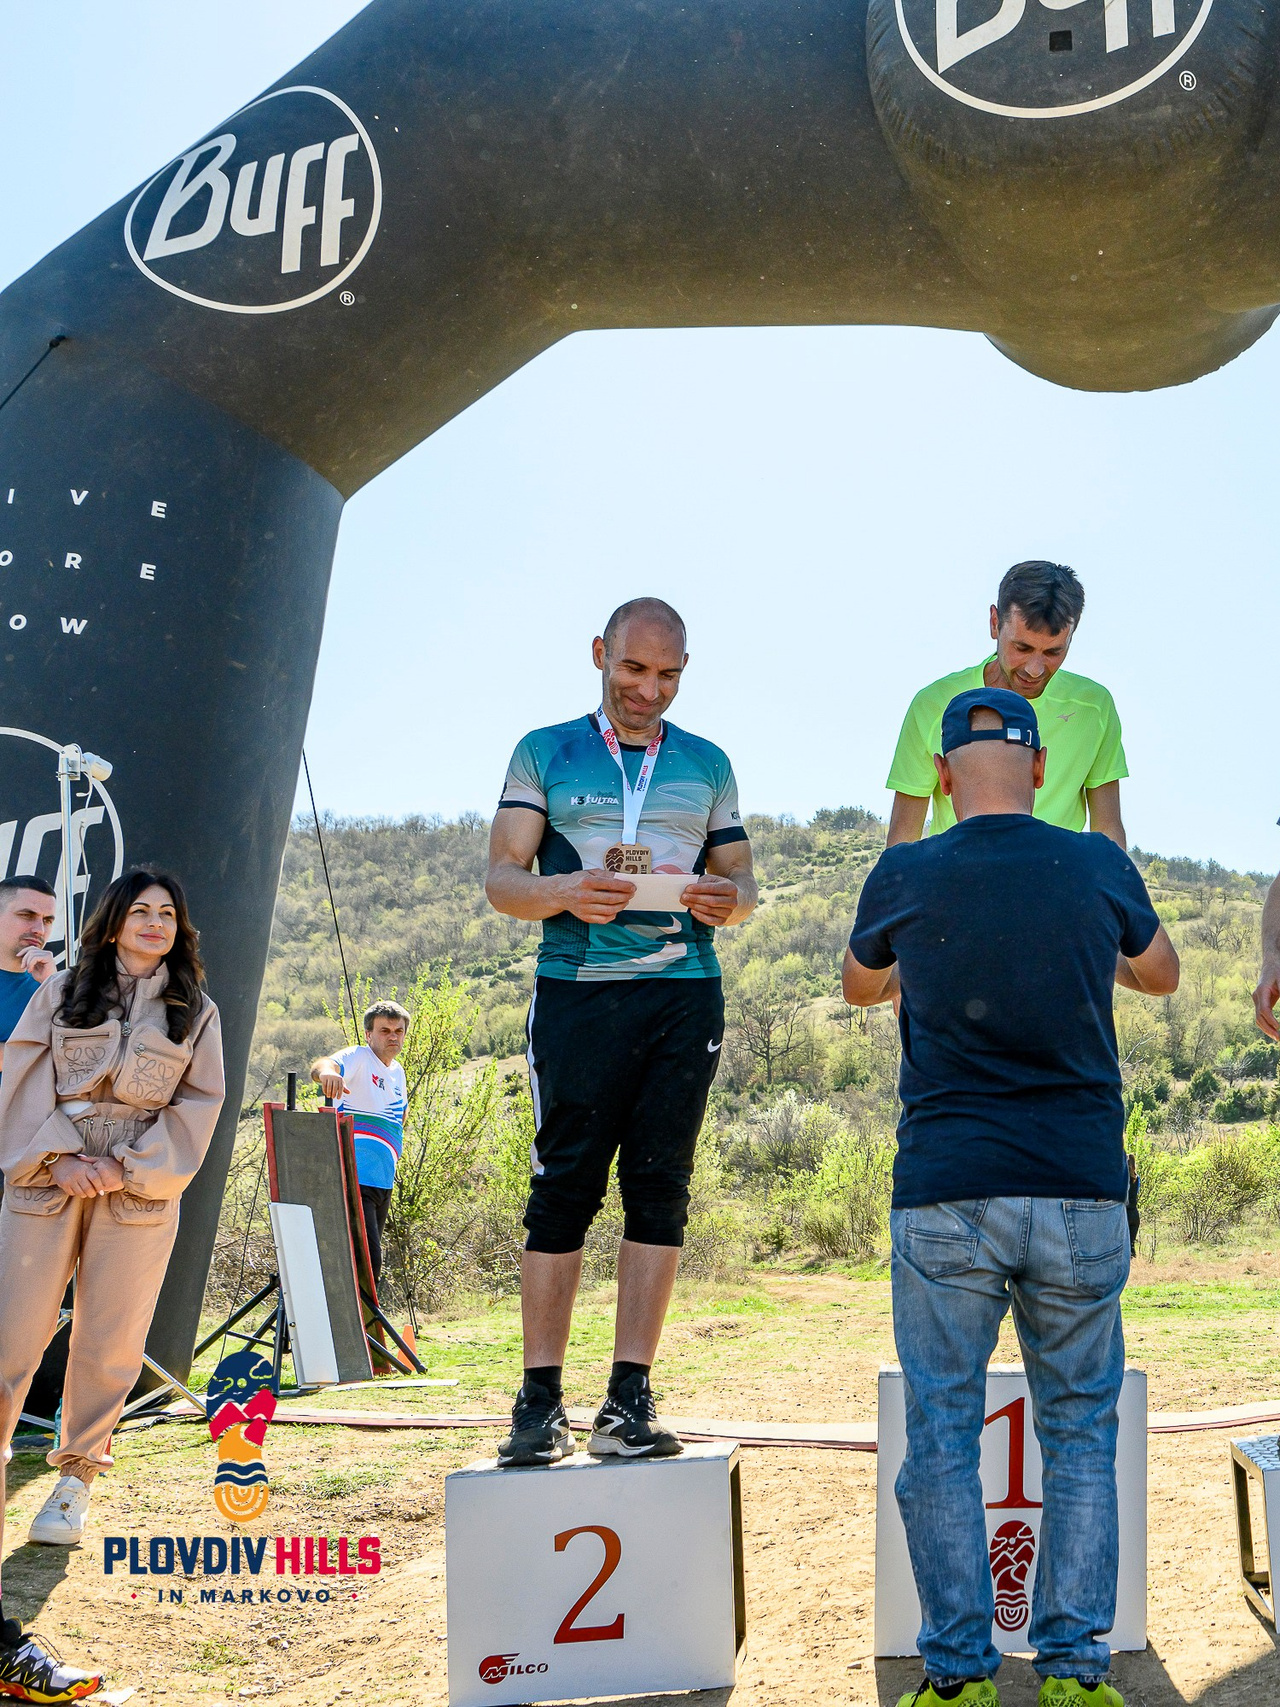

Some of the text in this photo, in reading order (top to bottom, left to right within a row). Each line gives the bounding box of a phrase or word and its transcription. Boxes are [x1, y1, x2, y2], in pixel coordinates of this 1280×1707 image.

[6, 488, 167, 518] IVE
[0, 551, 157, 581] ORE
[9, 615, 88, 635] OW
[984, 1397, 1043, 1509] 1
[553, 1525, 625, 1645] 2
